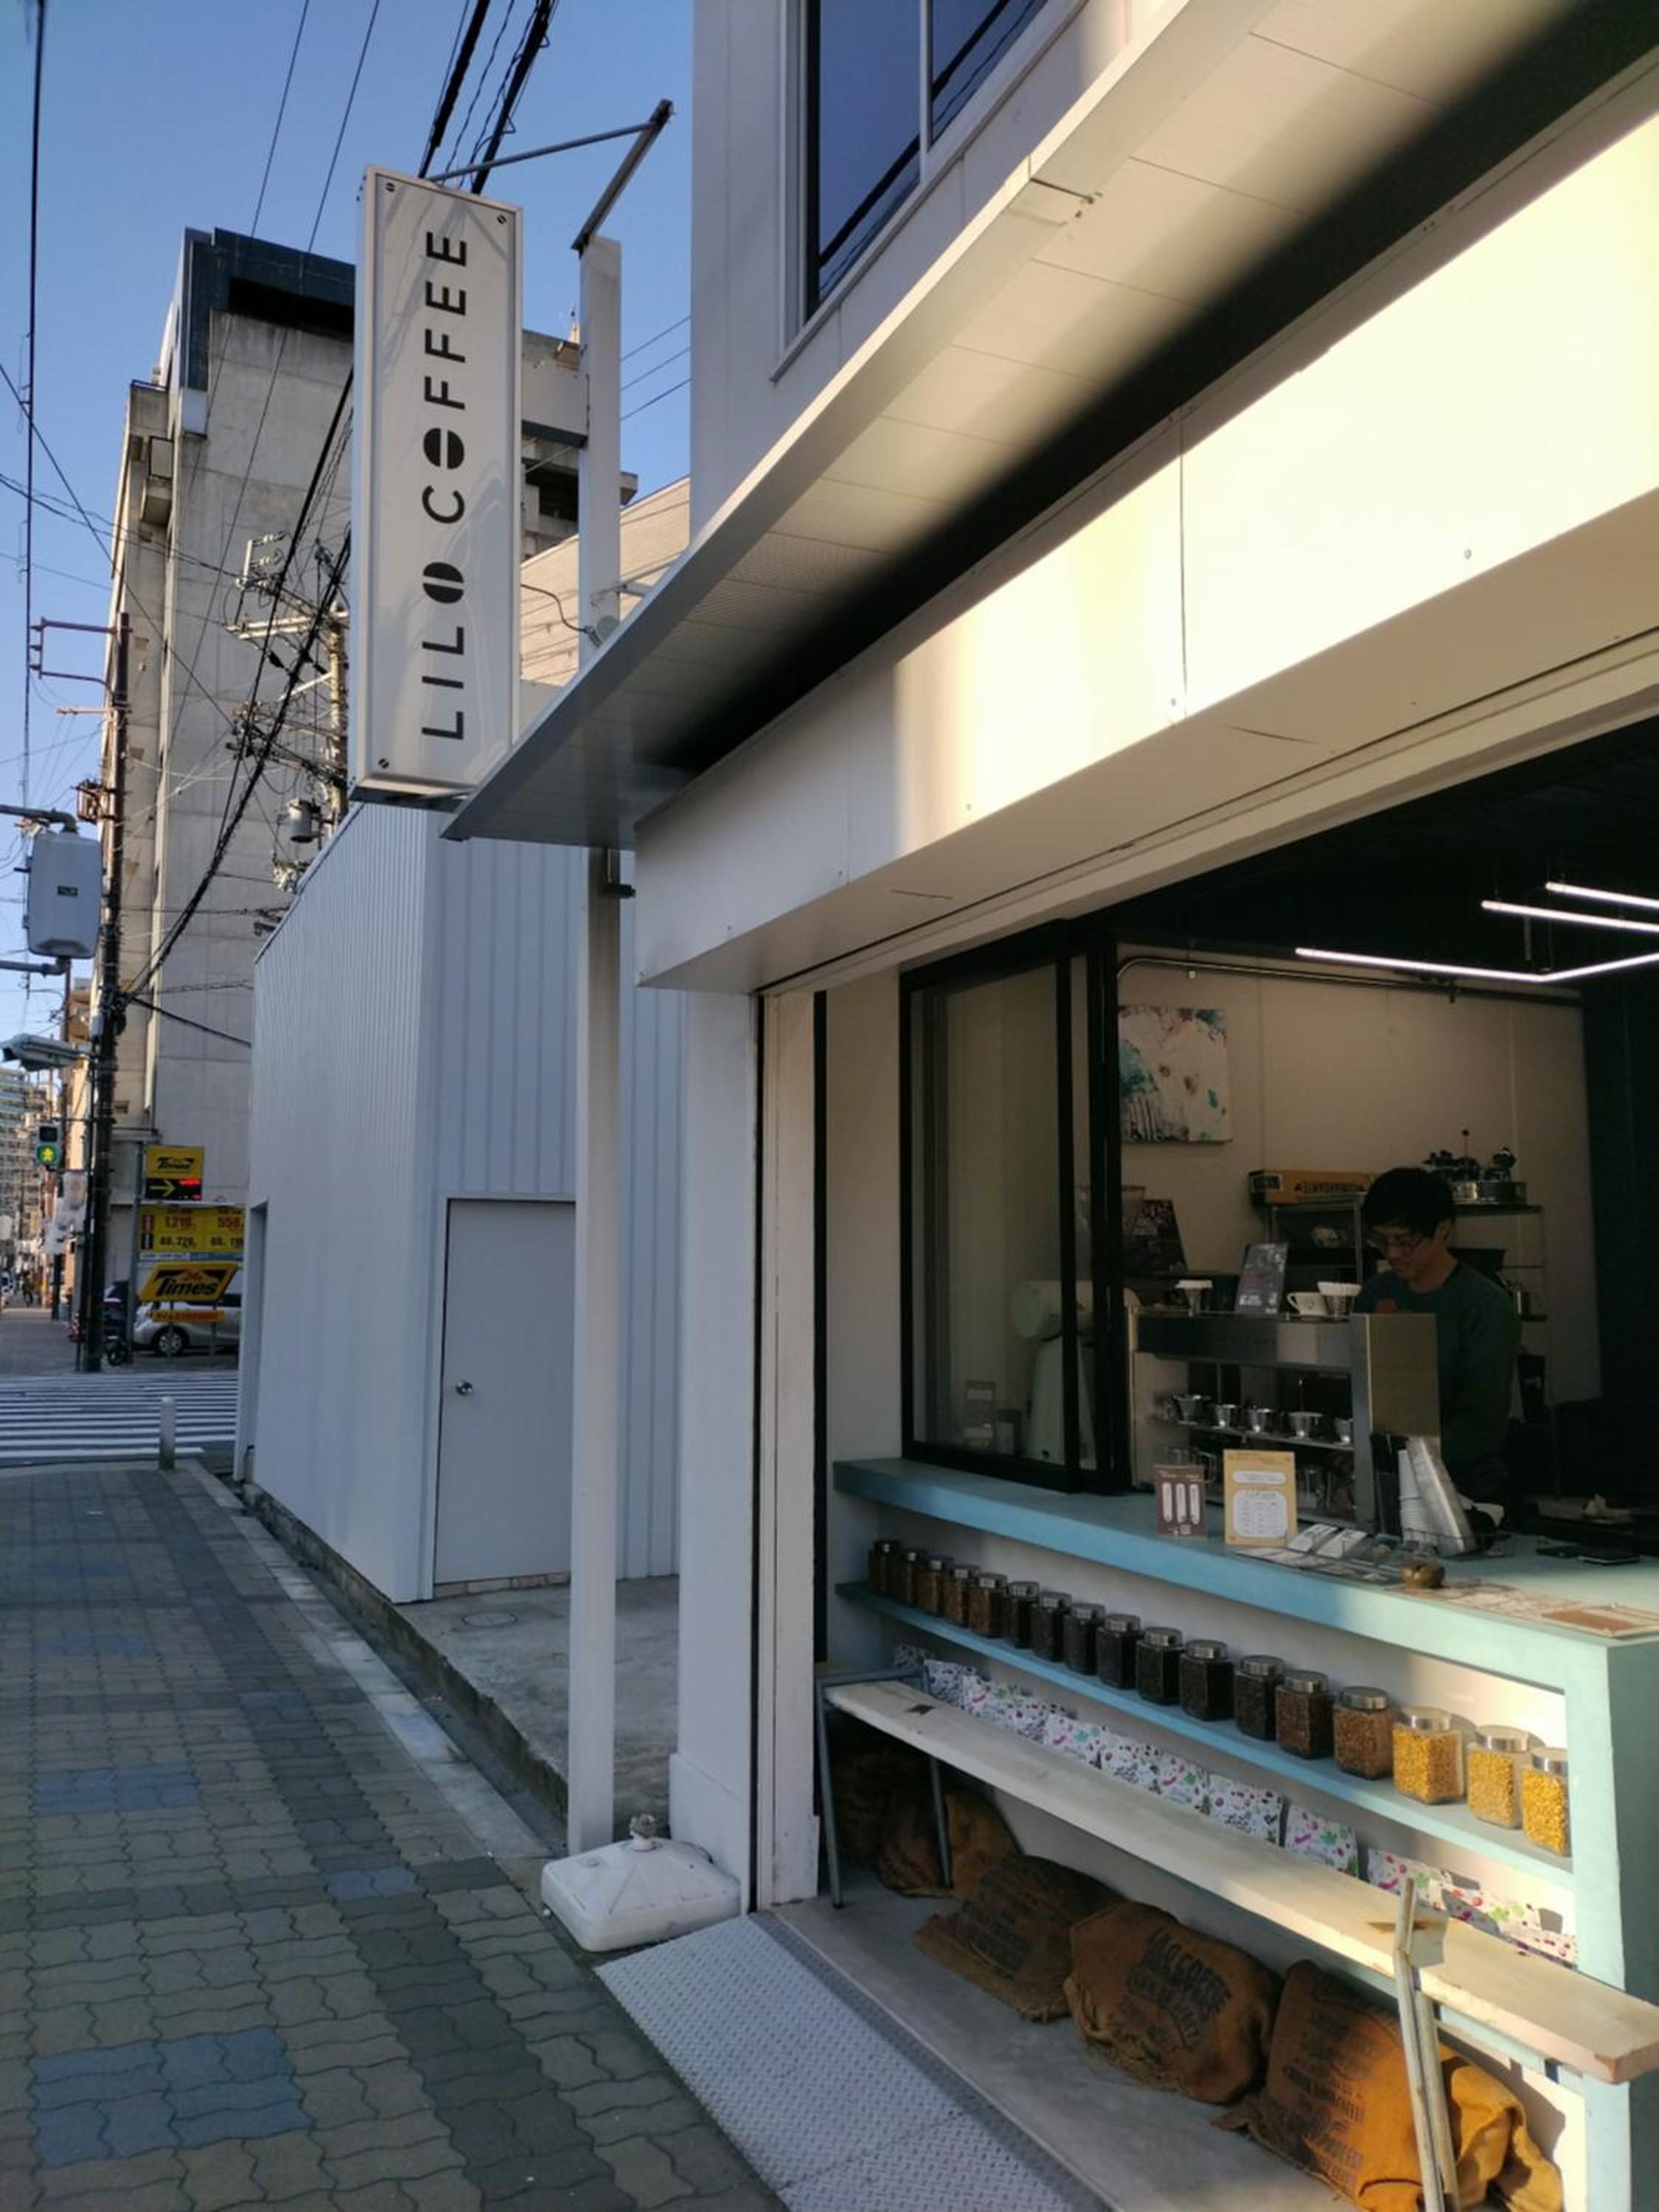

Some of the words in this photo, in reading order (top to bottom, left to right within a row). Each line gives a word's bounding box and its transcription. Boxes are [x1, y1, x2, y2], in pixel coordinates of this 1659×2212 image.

[422, 230, 468, 524] COFFEE
[421, 561, 465, 741] LILO
[156, 1270, 220, 1297] Times
